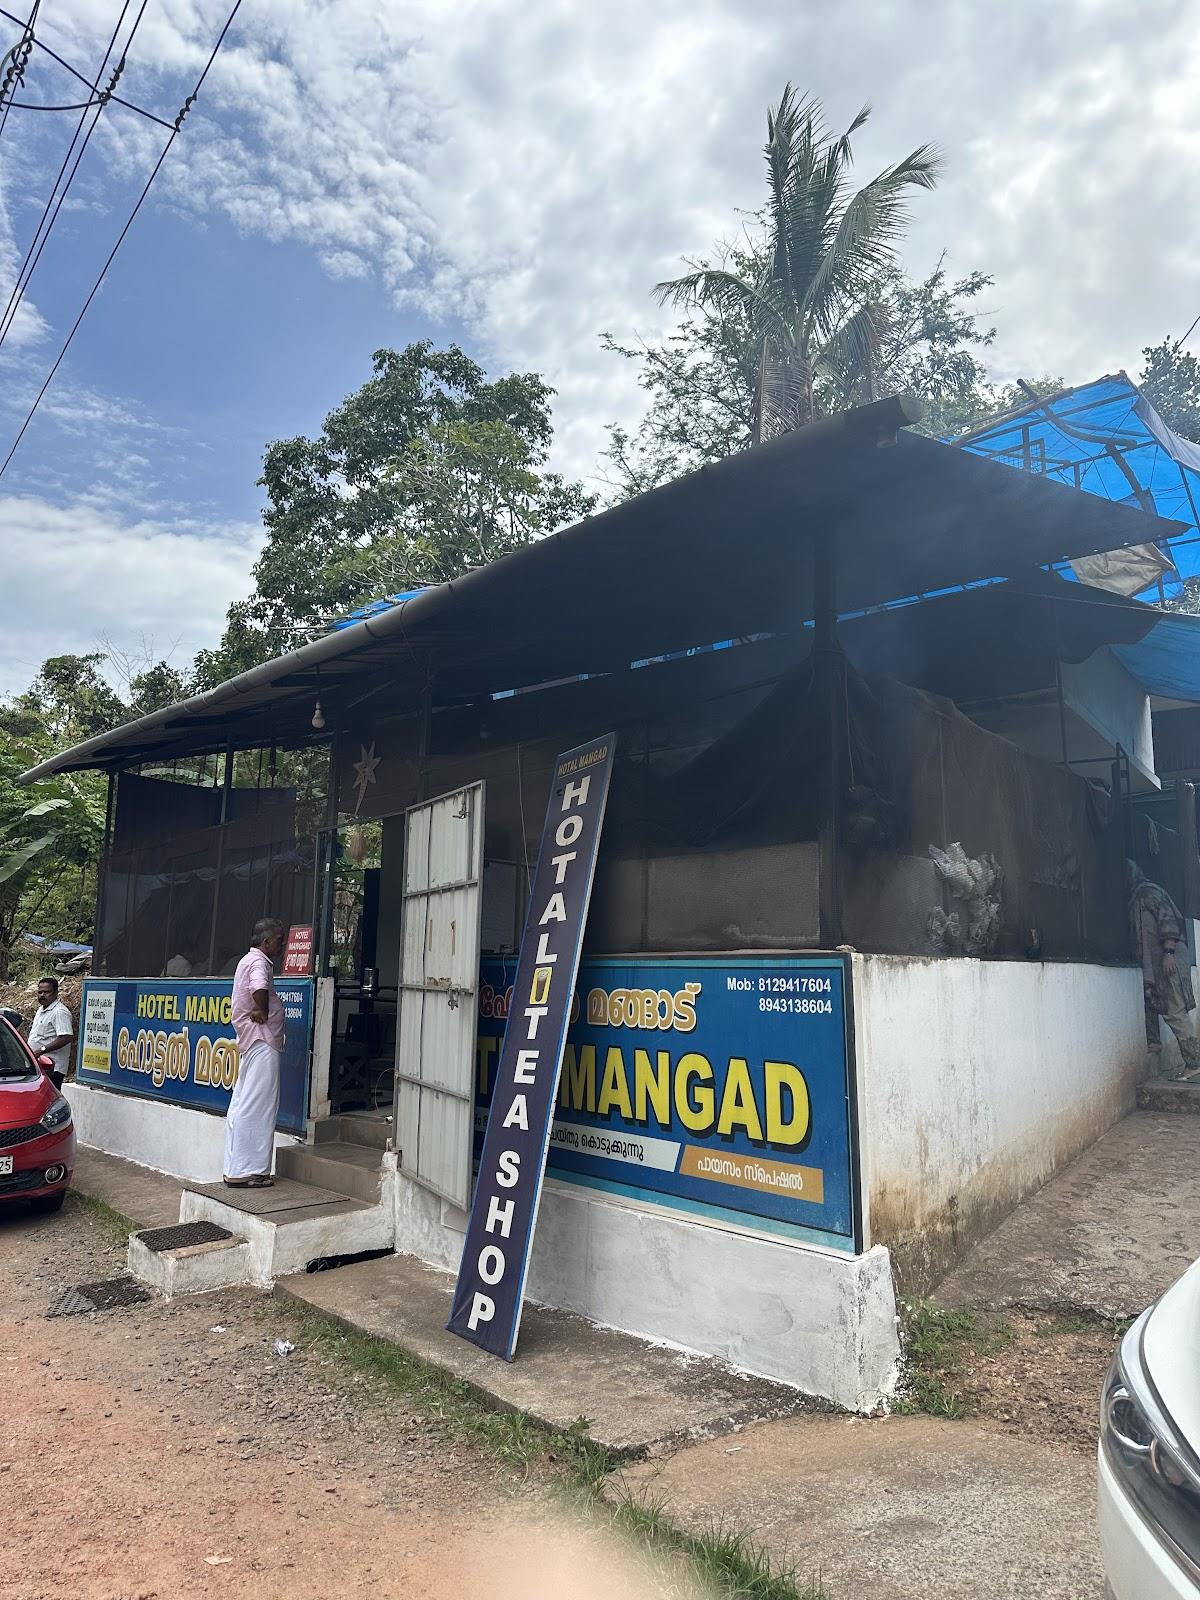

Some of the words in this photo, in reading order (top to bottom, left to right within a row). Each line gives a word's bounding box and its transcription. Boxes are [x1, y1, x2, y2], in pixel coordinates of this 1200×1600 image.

[579, 746, 608, 769] MANGAD
[535, 775, 591, 965] HOTAL
[727, 977, 755, 991] Mob:
[758, 977, 832, 993] 8129417604
[137, 994, 181, 1021] HOTEL
[184, 995, 232, 1025] MANG
[587, 982, 702, 1032] മങ്ങാട്
[759, 998, 833, 1014] 8943138604
[117, 1026, 191, 1087] ഹോട്ടൽ
[502, 1006, 549, 1131] TEA
[560, 1043, 813, 1147] MANGAD
[582, 1134, 644, 1162] കൊടുക്കുന്നു
[697, 1156, 742, 1179] പായസം
[467, 1150, 521, 1332] SHOP
